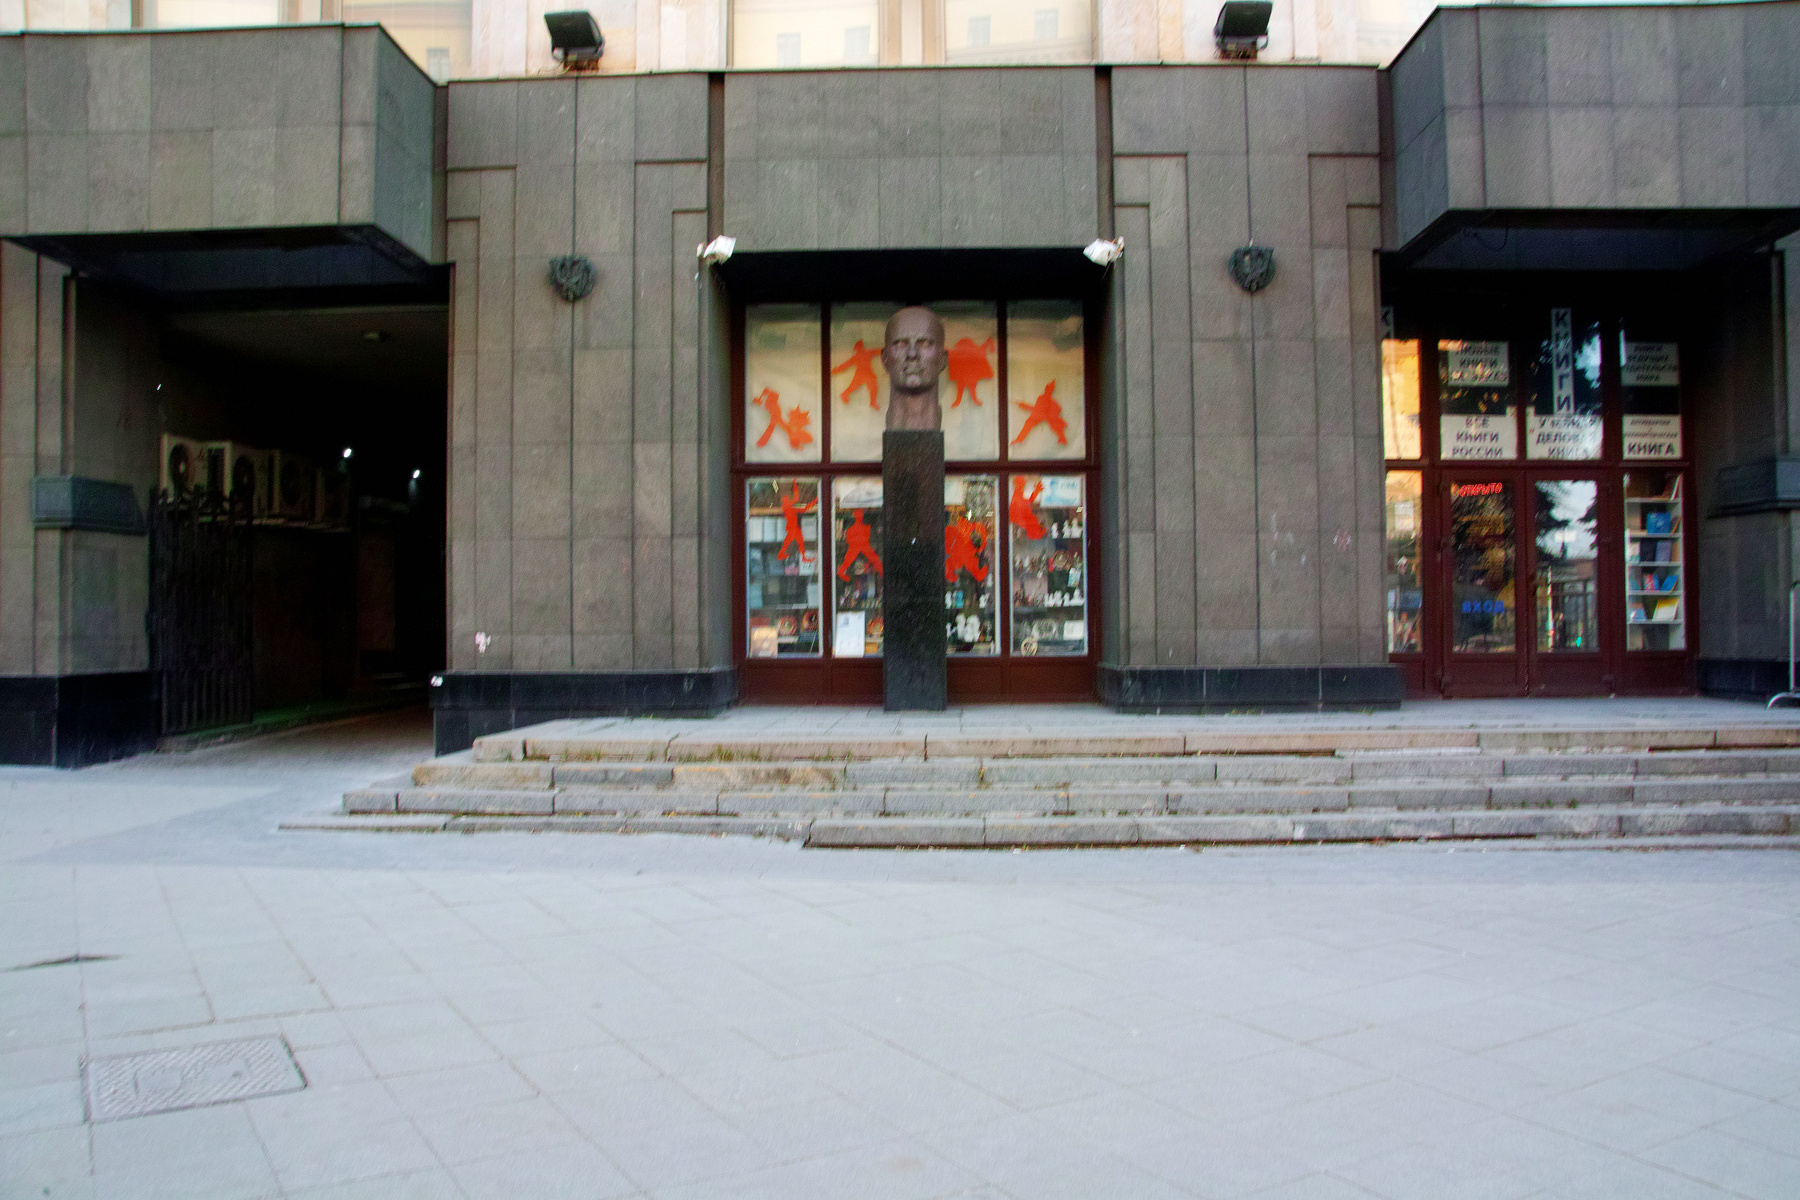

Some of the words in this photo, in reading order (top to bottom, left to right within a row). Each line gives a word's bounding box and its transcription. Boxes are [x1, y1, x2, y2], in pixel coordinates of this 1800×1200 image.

[1464, 415, 1489, 428] ВСЕ
[1456, 431, 1500, 443] КНИГИ
[1451, 445, 1503, 458] РОССИИ
[1627, 441, 1677, 456] КНИГА
[1459, 481, 1503, 498] ОТКРЫТО
[1461, 600, 1506, 615] ВХОД
